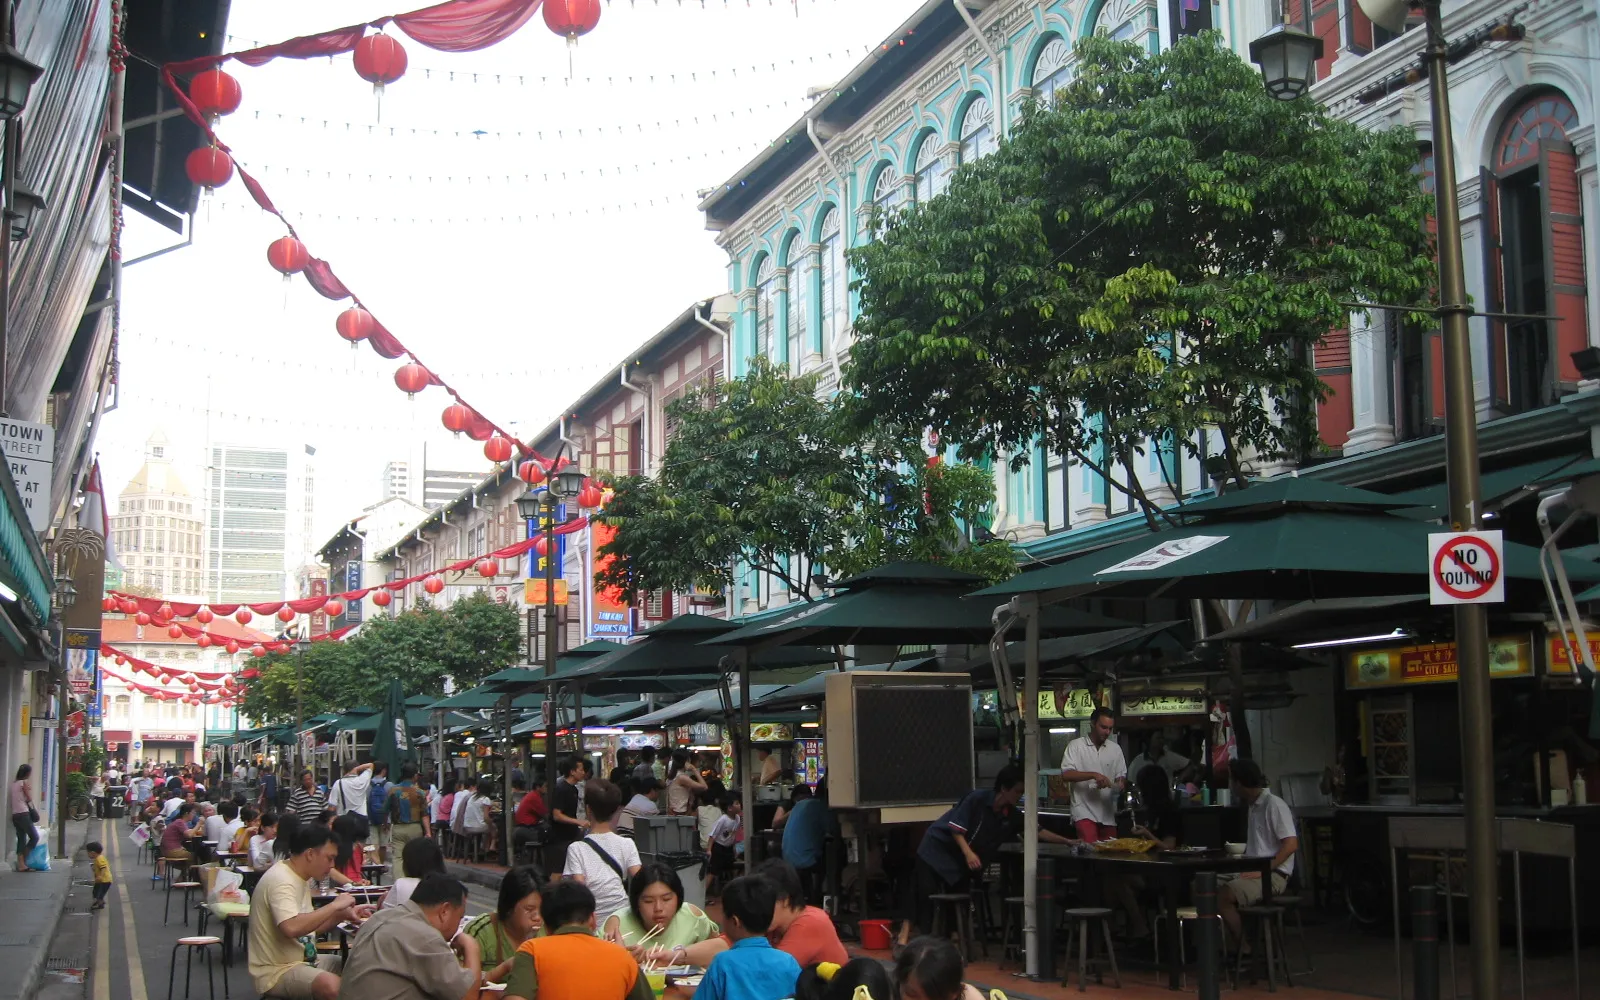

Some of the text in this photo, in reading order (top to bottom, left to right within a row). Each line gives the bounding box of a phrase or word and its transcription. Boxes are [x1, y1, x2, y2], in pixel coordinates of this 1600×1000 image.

[25, 481, 40, 494] AT
[1453, 549, 1478, 565] NO
[1439, 570, 1493, 585] TOUTING
[112, 796, 125, 808] 22
